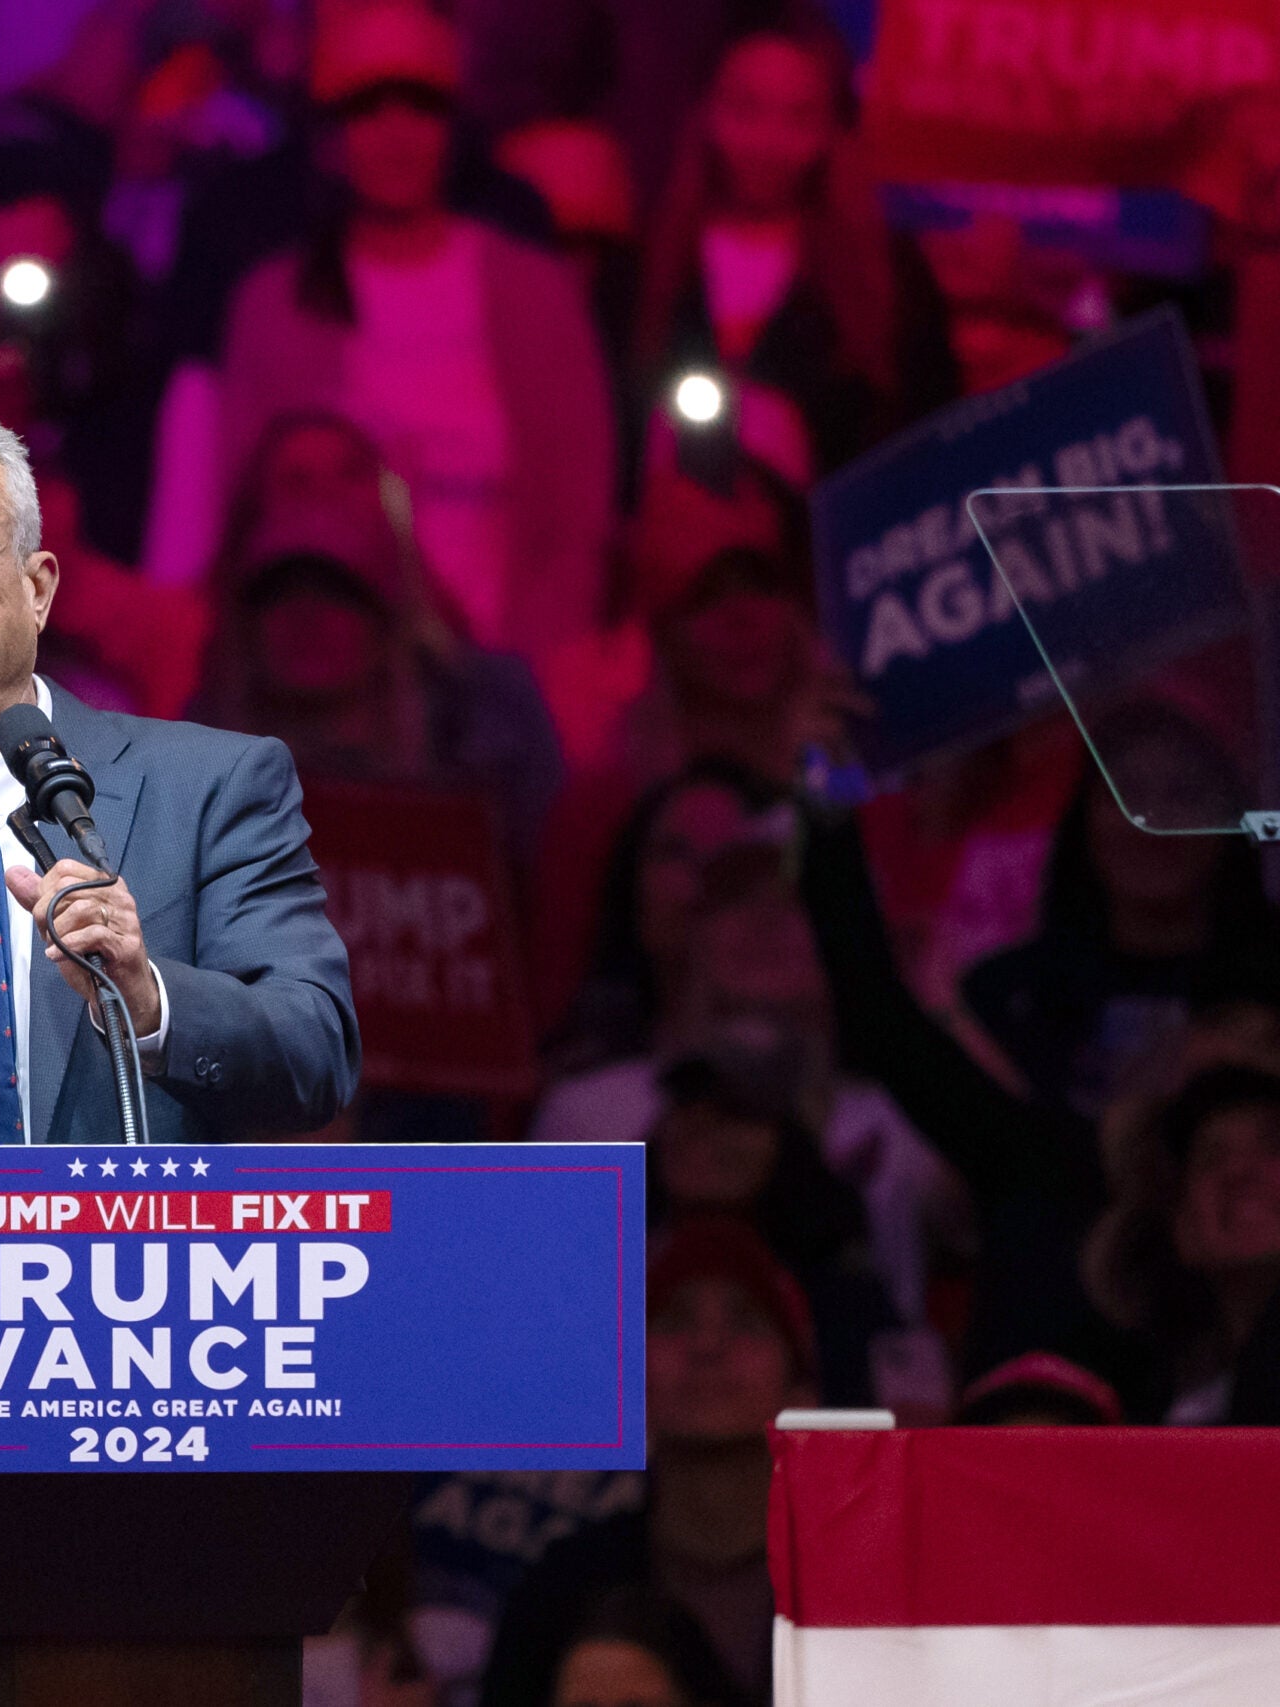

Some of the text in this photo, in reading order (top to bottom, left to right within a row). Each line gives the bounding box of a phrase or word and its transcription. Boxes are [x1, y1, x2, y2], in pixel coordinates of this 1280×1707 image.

[847, 463, 1049, 598] DREAM
[860, 482, 1177, 678] AGAIN!
[320, 868, 487, 949] UMP
[95, 1195, 216, 1230] WILL
[232, 1194, 310, 1230] FIX
[325, 1194, 370, 1230] IT
[20, 1399, 142, 1418] AMERICA
[152, 1399, 238, 1417] GREAT
[248, 1399, 341, 1417] AGAIN!
[69, 1426, 209, 1463] 2024
